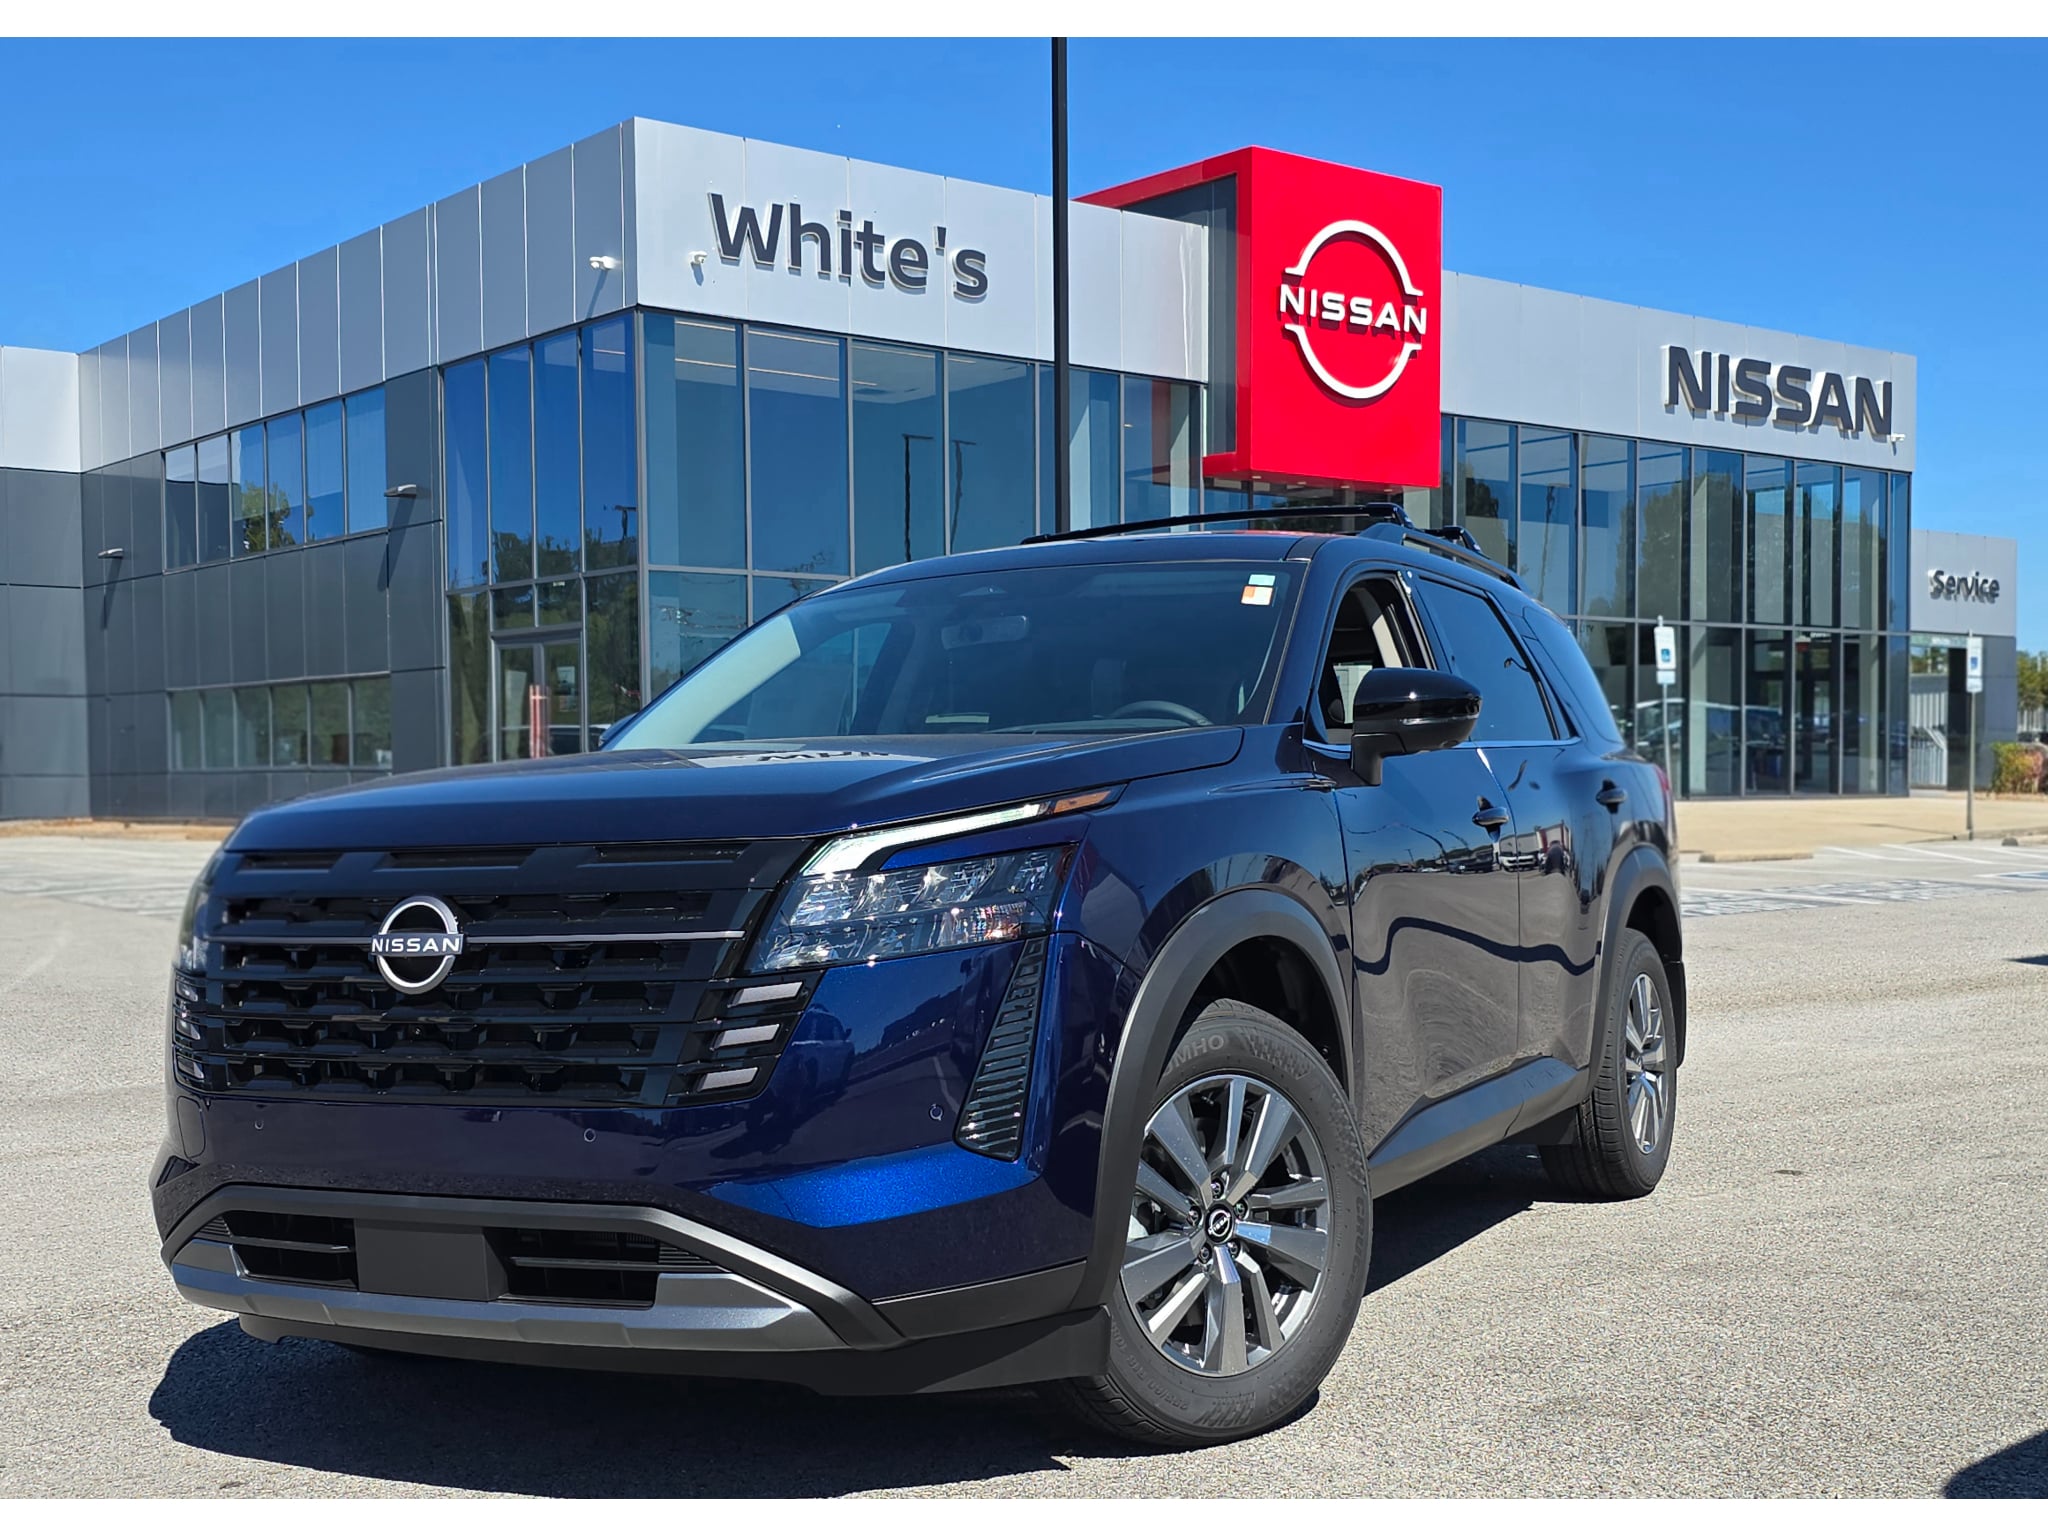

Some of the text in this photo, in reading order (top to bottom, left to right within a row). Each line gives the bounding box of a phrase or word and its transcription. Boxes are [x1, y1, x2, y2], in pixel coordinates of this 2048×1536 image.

[708, 192, 988, 299] White's
[1279, 284, 1427, 335] NISSAN
[1664, 345, 1892, 437] NISSAN
[1931, 570, 2000, 598] Service
[371, 937, 460, 953] NISSAN
